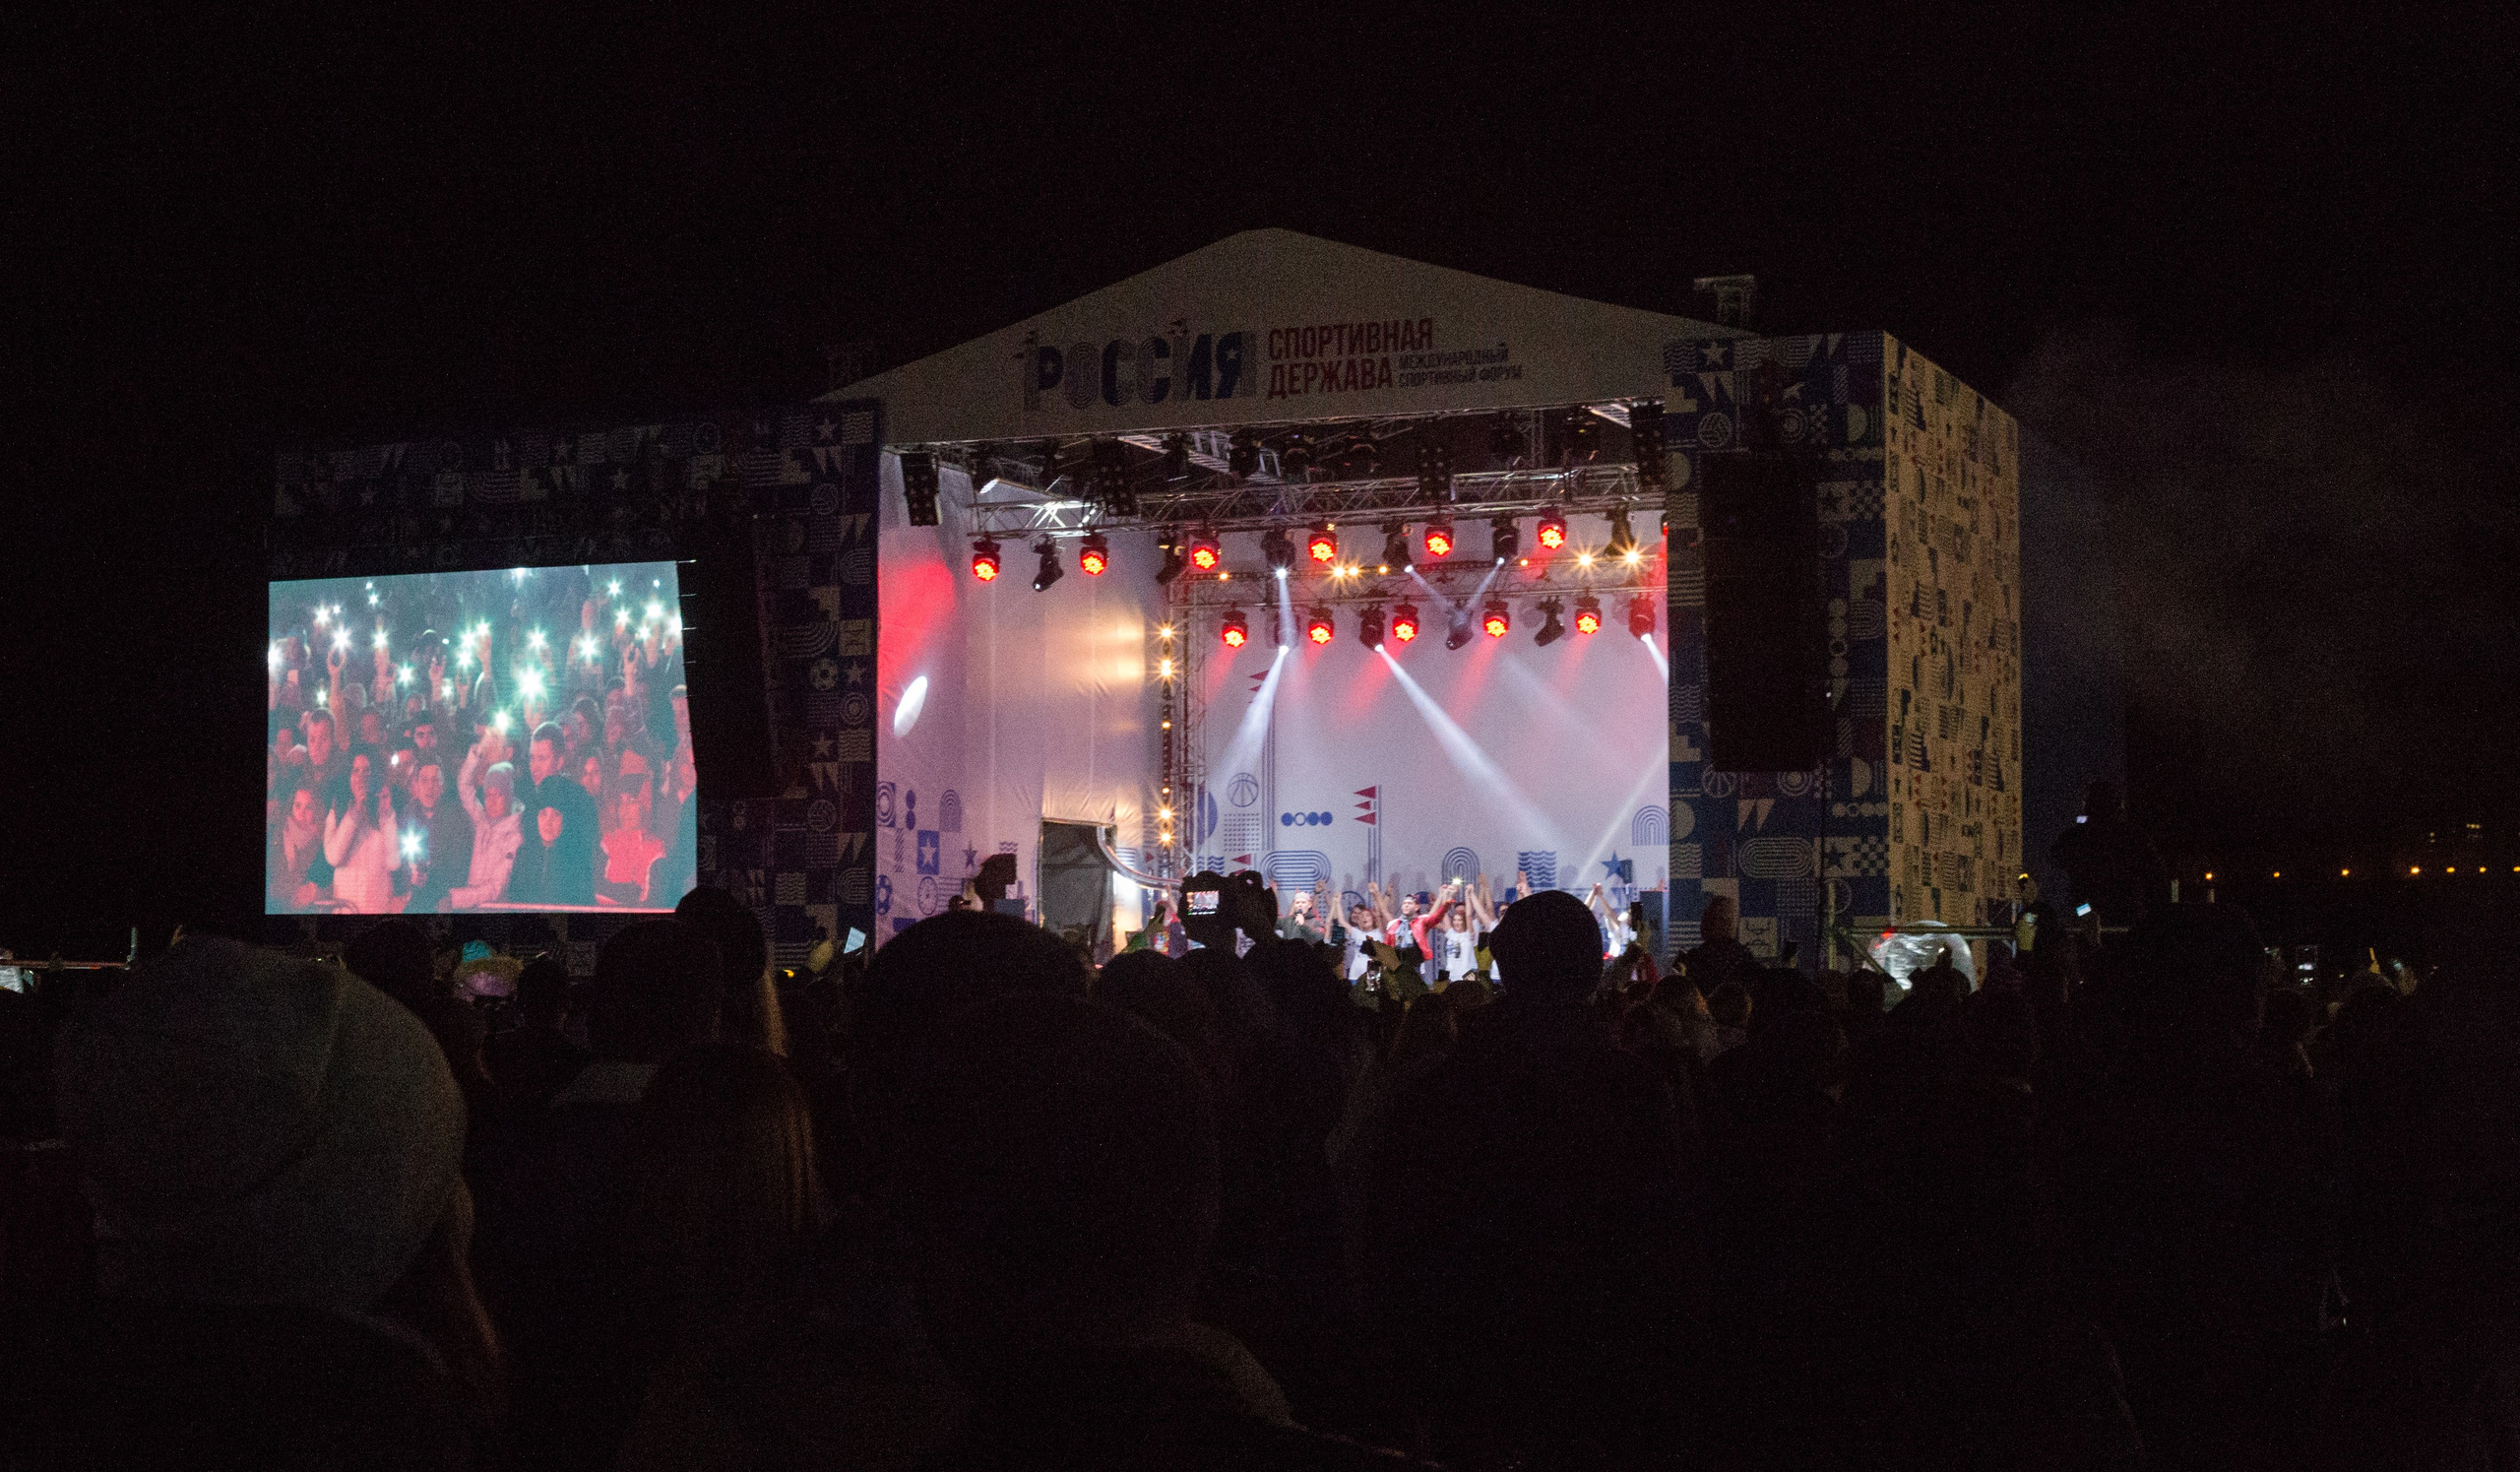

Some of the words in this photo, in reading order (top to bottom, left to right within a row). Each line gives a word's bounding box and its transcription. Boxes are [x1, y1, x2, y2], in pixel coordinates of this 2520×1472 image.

[1268, 318, 1433, 361] СПОРТИВНАЯ
[1398, 342, 1509, 370] МЕЖДУНАРОДНЫЙ
[1022, 329, 1256, 412] РОССИЯ
[1267, 356, 1393, 400] ДЕРЖАВА
